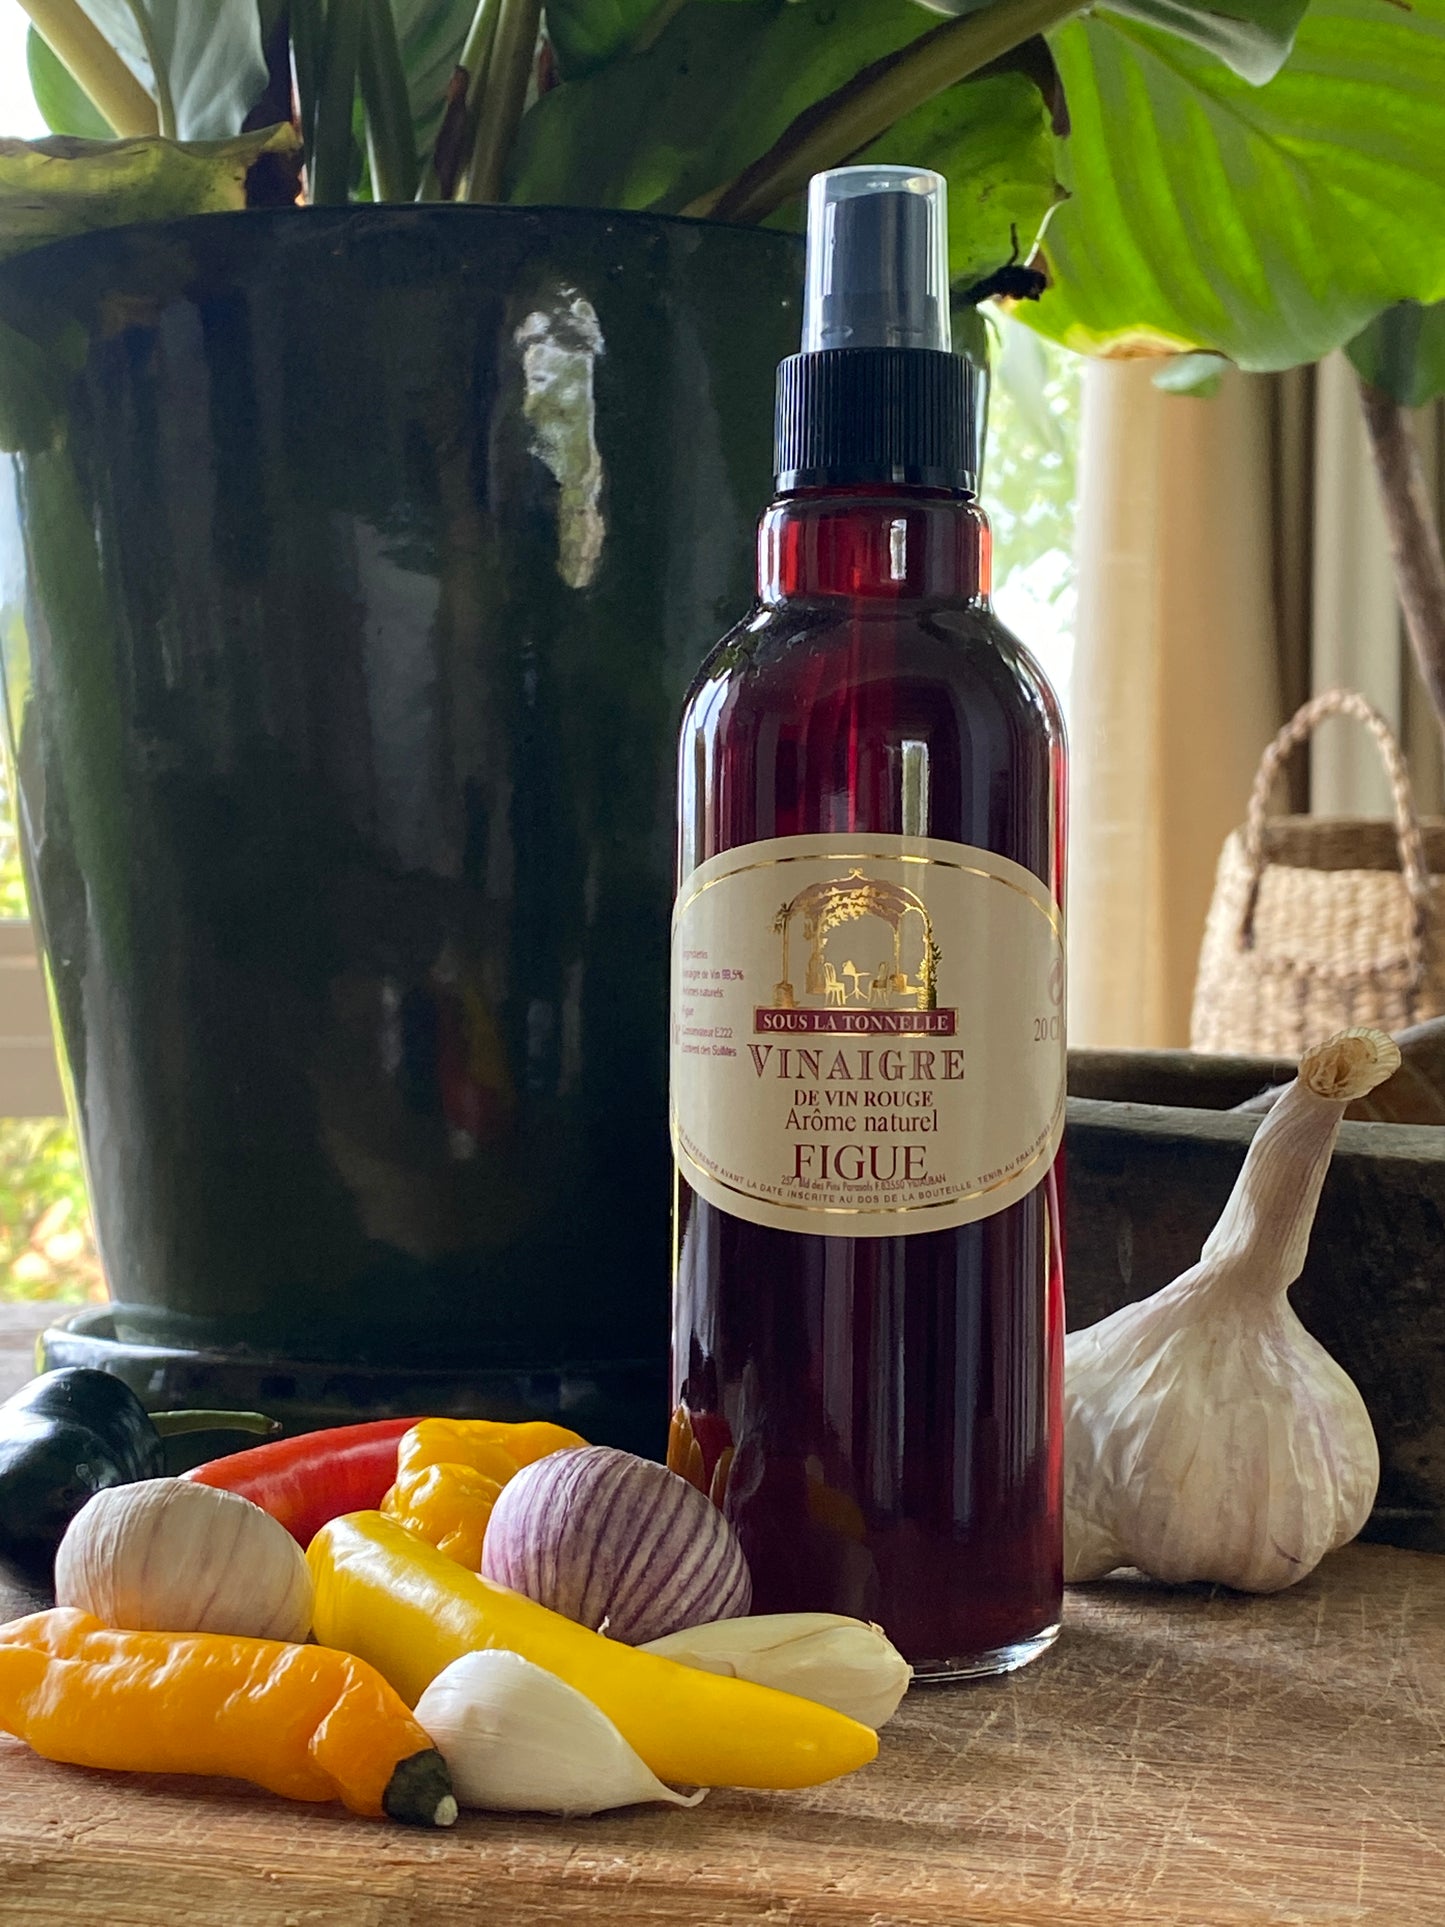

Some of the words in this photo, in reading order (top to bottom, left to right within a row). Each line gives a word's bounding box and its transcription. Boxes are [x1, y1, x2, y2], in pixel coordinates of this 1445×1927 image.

[763, 1014, 808, 1030] SOUS
[814, 1015, 839, 1031] LA
[842, 1015, 949, 1031] TONNELLE
[1033, 1017, 1048, 1042] 20
[747, 1043, 965, 1081] VINAIGRE
[794, 1089, 819, 1107] DE
[825, 1090, 858, 1107] VIN
[864, 1090, 934, 1108] ROUGE
[785, 1107, 857, 1132] Arôme
[864, 1108, 939, 1132] naturel
[793, 1143, 928, 1181] FIGUE
[760, 1185, 784, 1197] DATE
[786, 1189, 836, 1203] INSCRITE
[839, 1195, 854, 1204] AU
[857, 1194, 880, 1204] DOS
[883, 1194, 899, 1204] DE
[901, 1192, 916, 1202] LA
